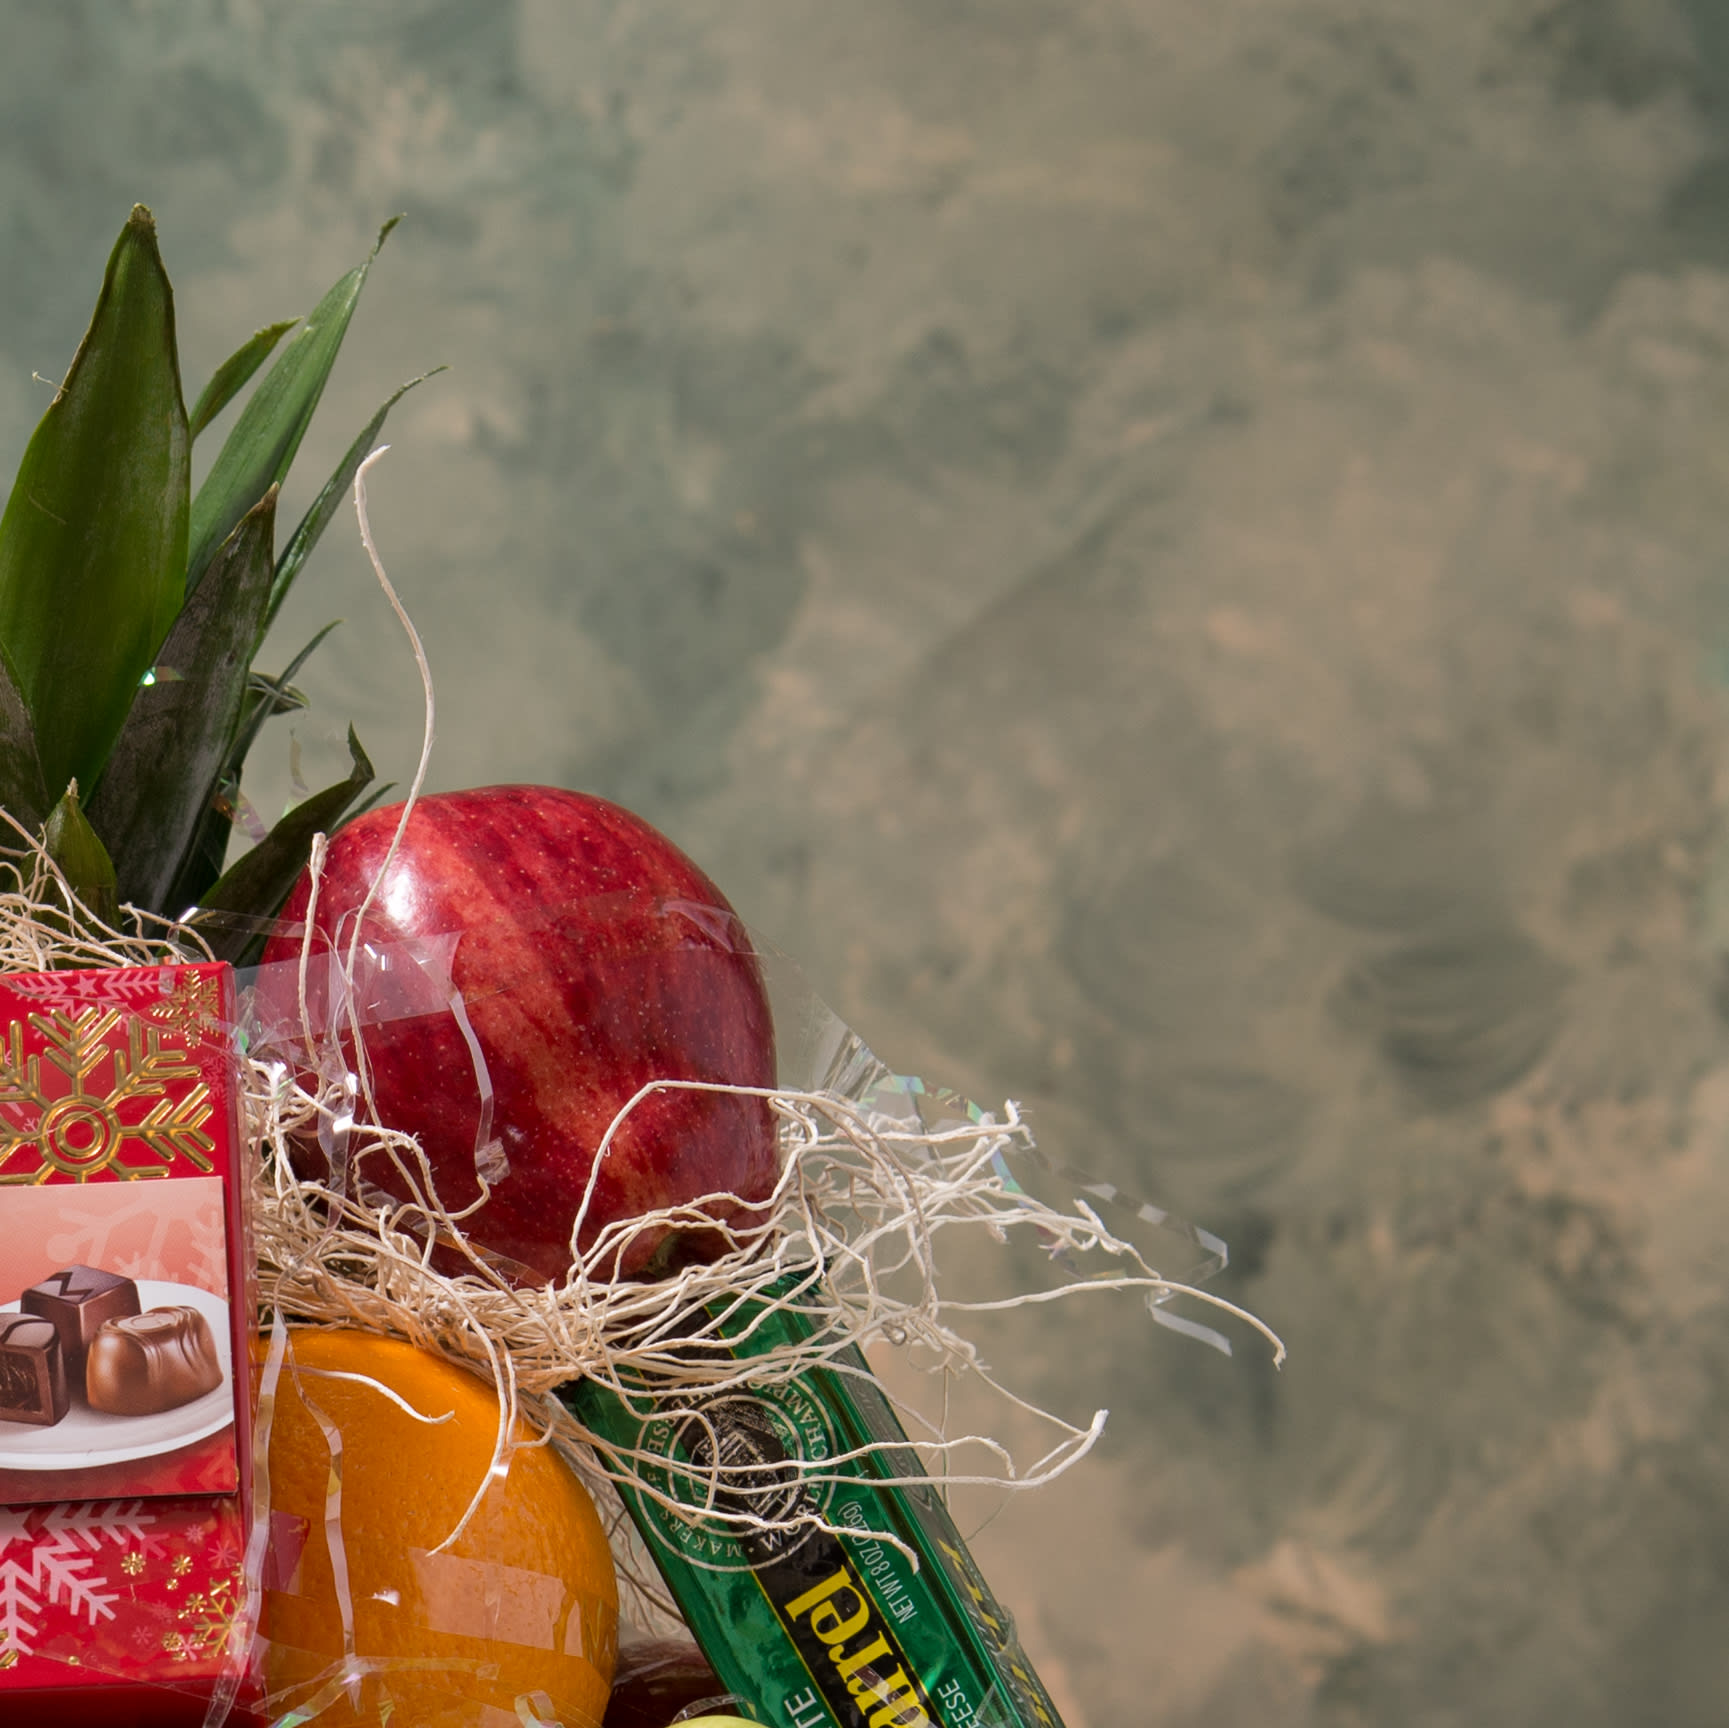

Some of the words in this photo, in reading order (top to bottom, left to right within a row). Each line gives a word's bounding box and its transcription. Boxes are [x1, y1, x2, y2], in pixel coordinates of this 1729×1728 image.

[860, 1541, 884, 1566] OZ
[870, 1561, 890, 1576] 8
[875, 1571, 903, 1600] WT
[888, 1594, 918, 1624] NET
